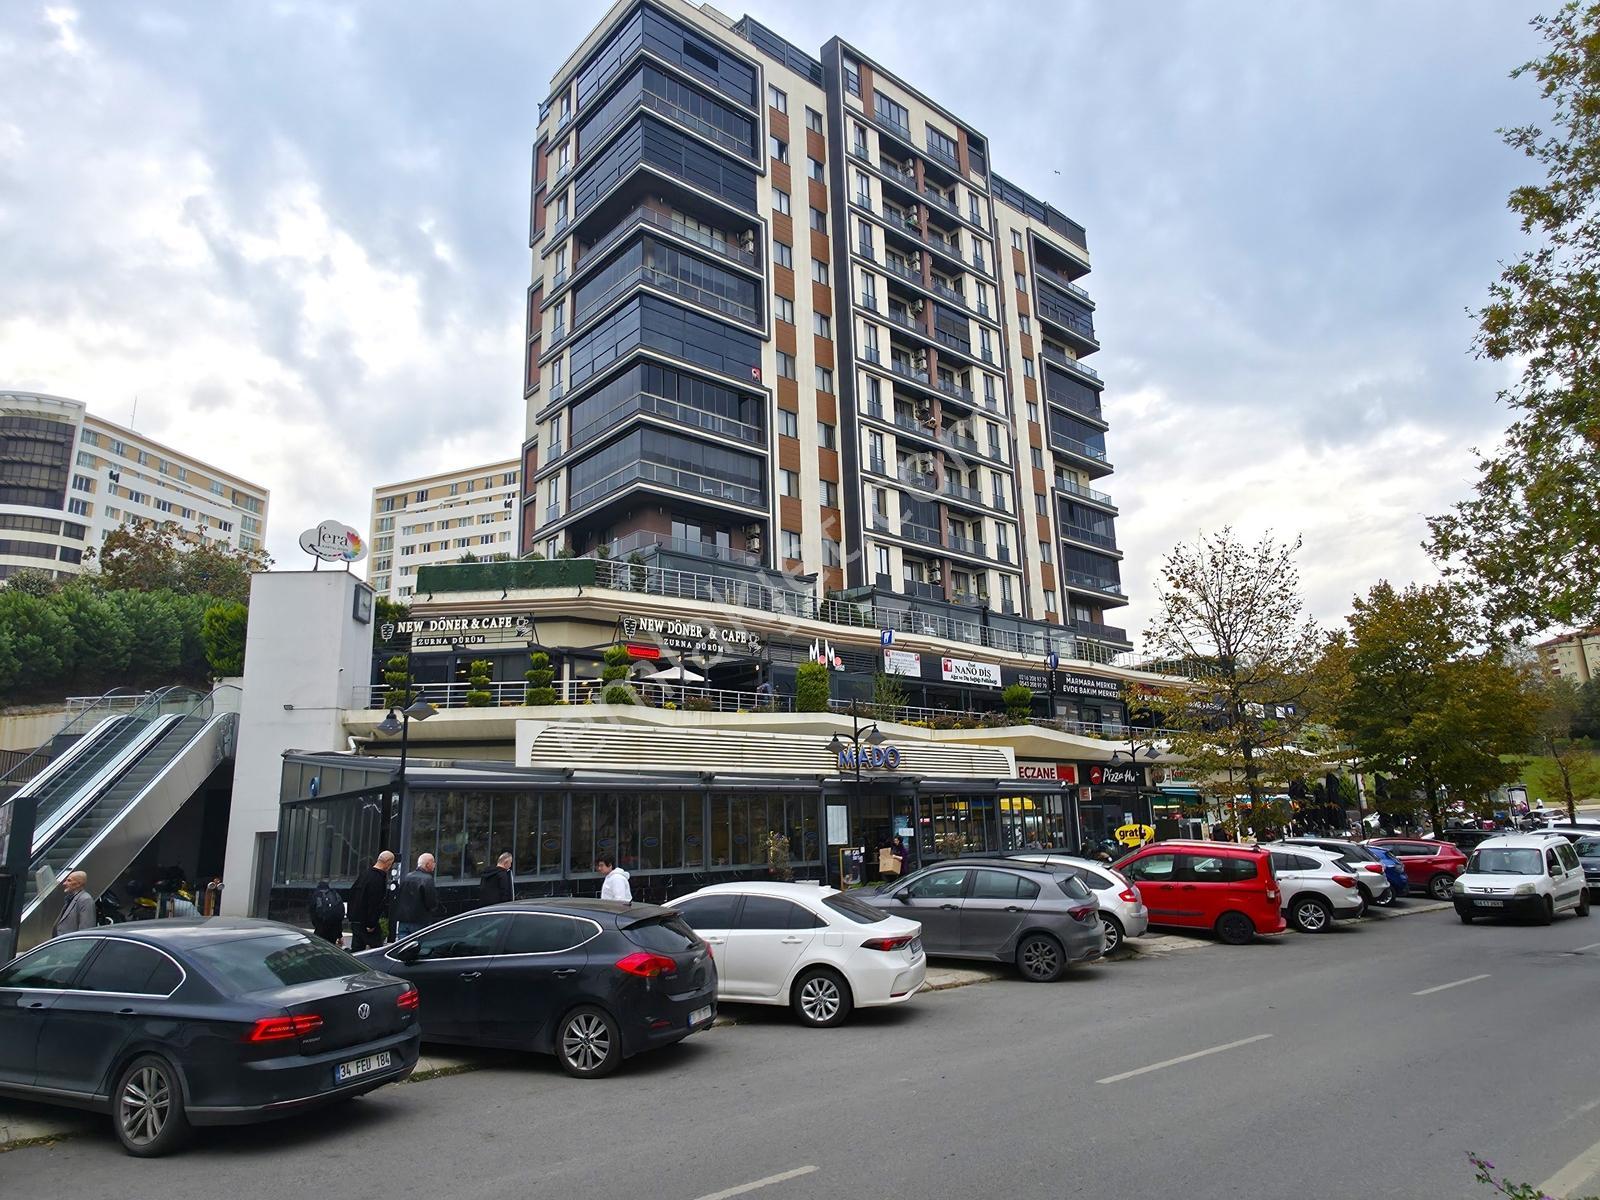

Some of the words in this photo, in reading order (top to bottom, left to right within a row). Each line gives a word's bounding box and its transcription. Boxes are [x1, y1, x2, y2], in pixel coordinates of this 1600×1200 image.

[318, 525, 347, 547] fera
[397, 621, 424, 633] NEW
[430, 617, 469, 632] DÖNER
[471, 618, 480, 629] &
[482, 617, 512, 629] CAFE
[640, 618, 664, 633] NEW
[667, 619, 703, 638] DÖNER
[709, 628, 717, 640] &
[721, 629, 747, 643] CAFE
[418, 638, 448, 646] ZURNA
[663, 638, 692, 649] ZURNA
[954, 665, 978, 676] NANO
[979, 667, 992, 679] DİŞ
[1063, 684, 1078, 693] EVDE
[1079, 687, 1098, 696] BAKIM
[1065, 677, 1095, 688] MARMARA
[1095, 681, 1117, 690] MERKEZ
[837, 743, 901, 770] MADO
[1018, 766, 1056, 779] ECZANE
[1102, 767, 1124, 784] Pizza
[1119, 828, 1146, 840] grat
[341, 1064, 351, 1078] 34
[356, 1057, 371, 1074] FEU
[376, 1052, 390, 1068] 184
